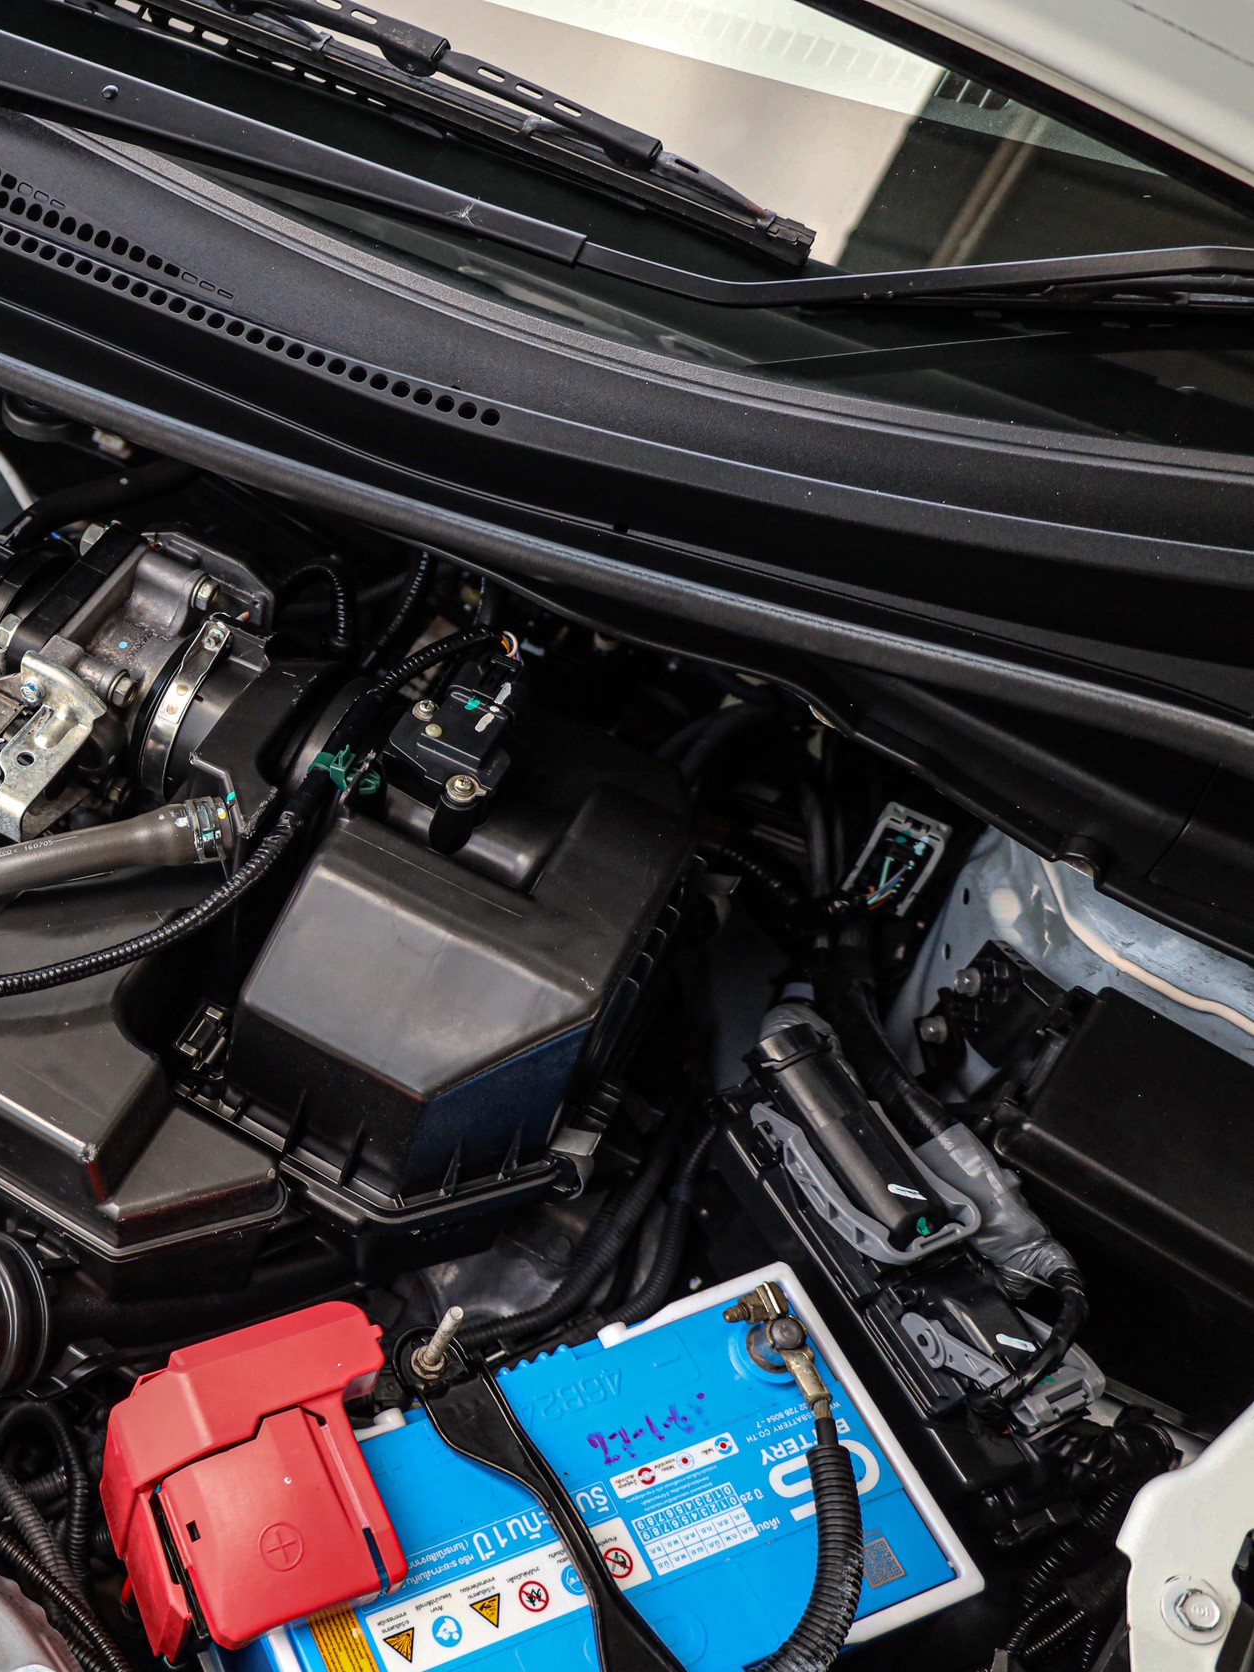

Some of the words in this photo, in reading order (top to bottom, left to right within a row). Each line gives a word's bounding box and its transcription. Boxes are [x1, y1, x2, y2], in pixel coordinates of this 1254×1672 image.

[784, 1405, 798, 1416] 726
[760, 1417, 849, 1465] BTTERY
[738, 1491, 753, 1503] 25
[752, 1486, 764, 1501] ปี
[755, 1515, 781, 1535] เดือน
[470, 1529, 497, 1562] ปี
[492, 1523, 509, 1548] 1
[456, 1552, 475, 1567] หรือ
[405, 1558, 458, 1588] ระยะทางไม่เกิน
